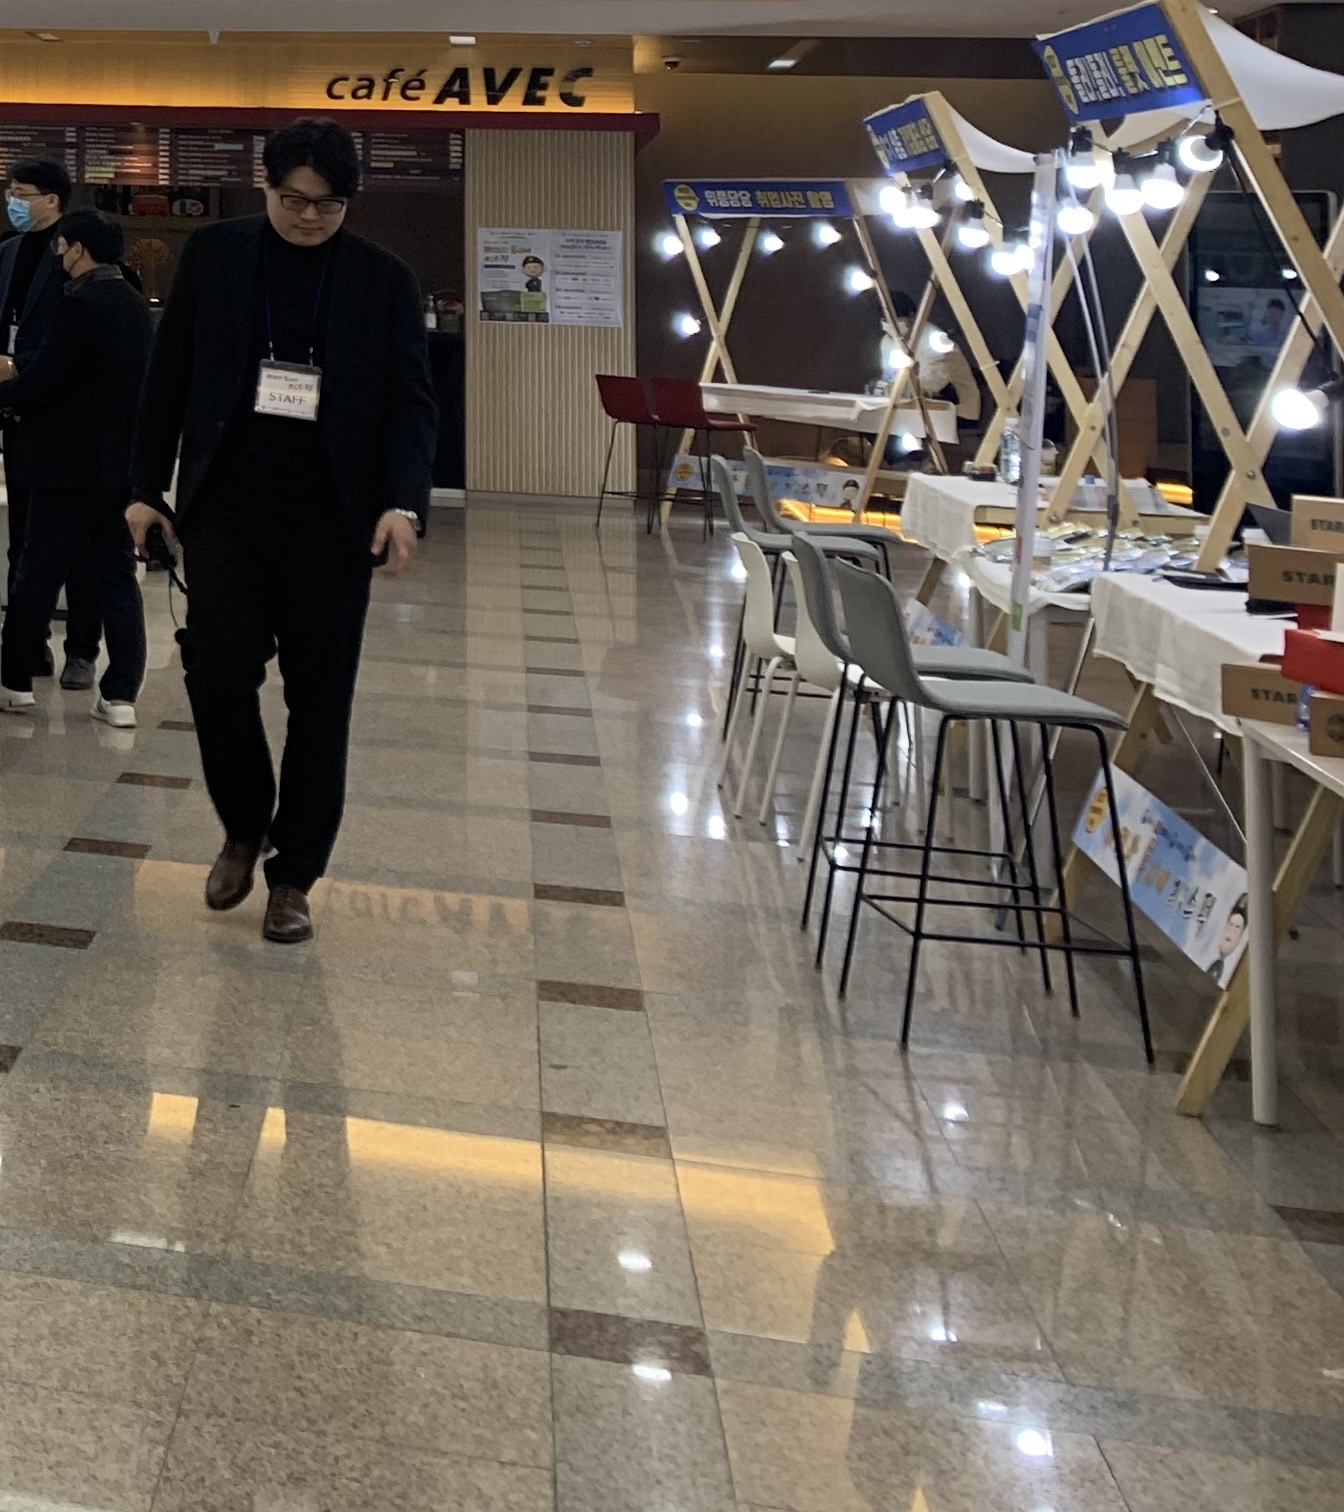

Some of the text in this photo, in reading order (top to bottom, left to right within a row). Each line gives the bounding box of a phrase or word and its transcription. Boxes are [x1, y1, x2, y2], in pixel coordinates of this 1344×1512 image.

[326, 66, 595, 108] café AVEC
[268, 392, 307, 406] STAFF
